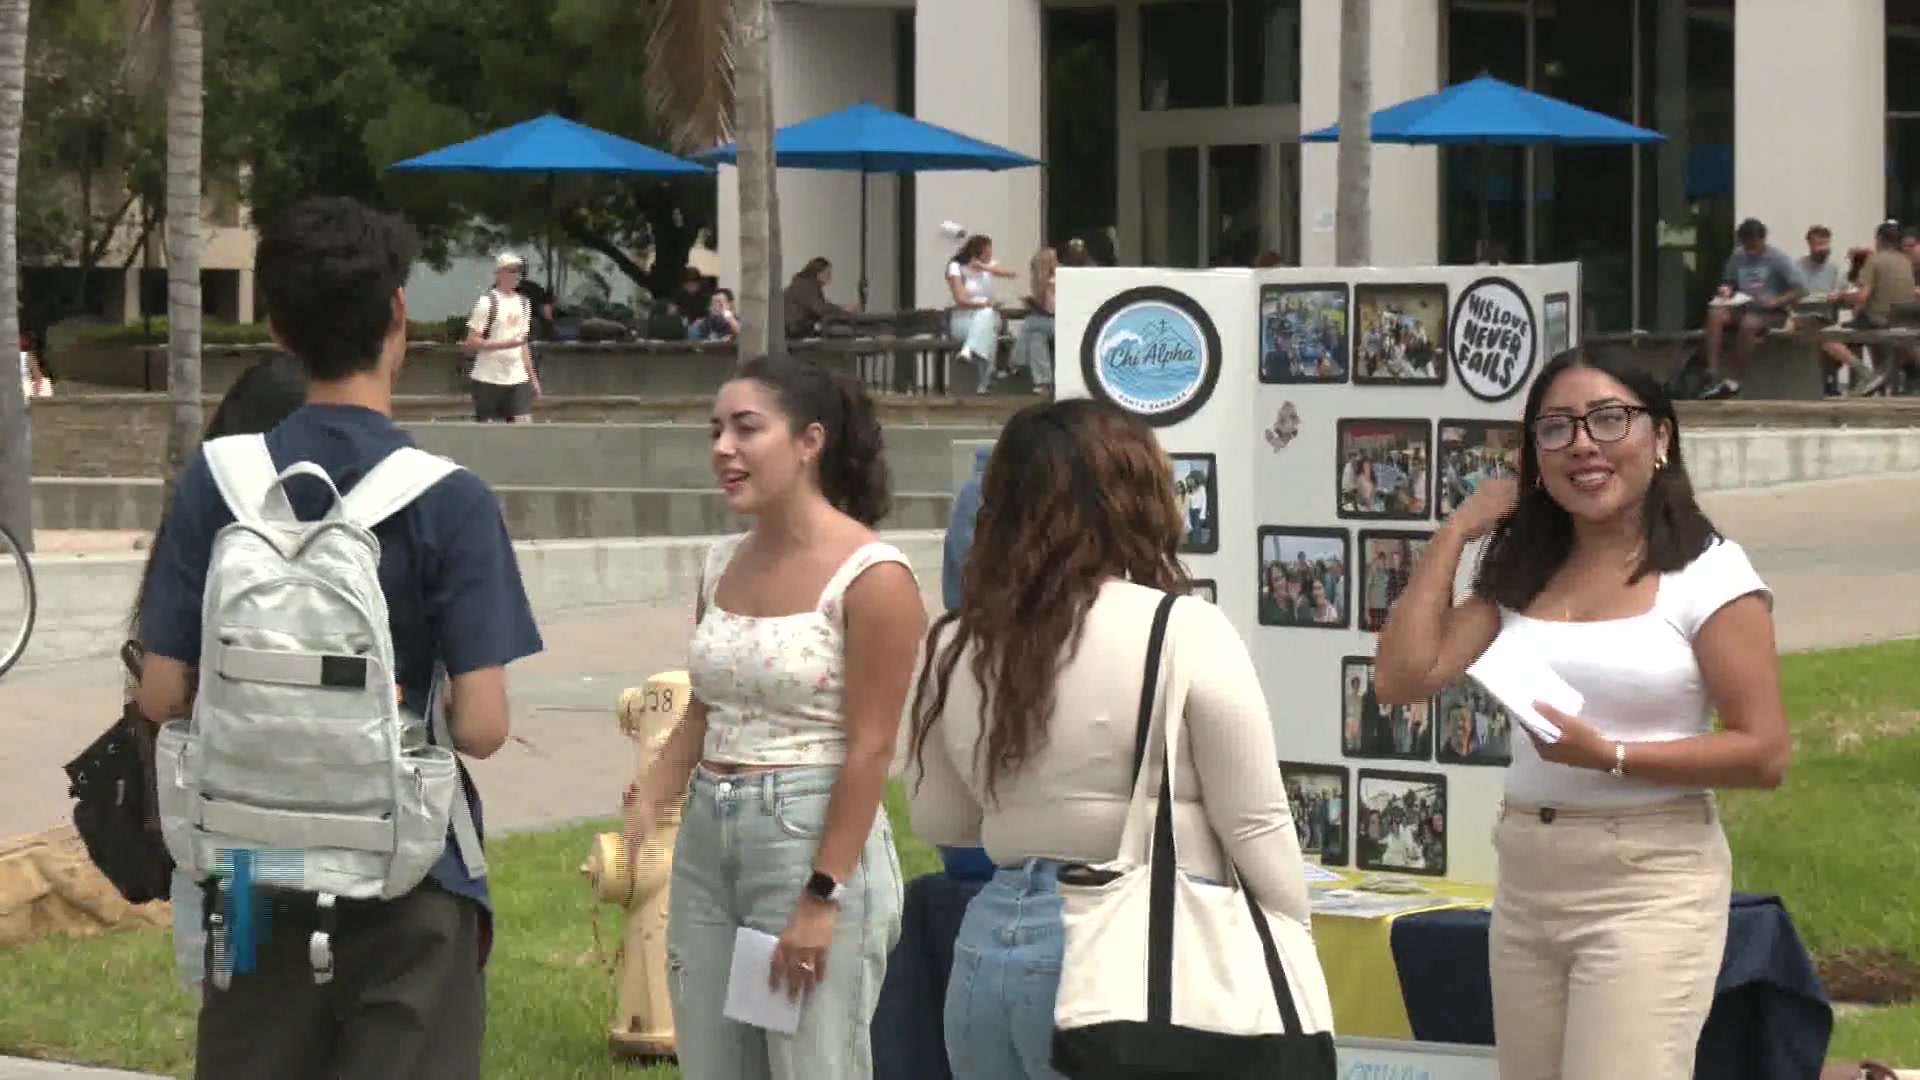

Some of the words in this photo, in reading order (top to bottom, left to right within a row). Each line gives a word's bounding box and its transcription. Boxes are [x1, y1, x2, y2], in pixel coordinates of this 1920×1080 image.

[1463, 319, 1522, 361] NEVER
[1492, 308, 1528, 337] LOVE
[1110, 347, 1139, 369] Chi
[1142, 343, 1195, 369] Alpha
[1458, 343, 1514, 388] FAILS
